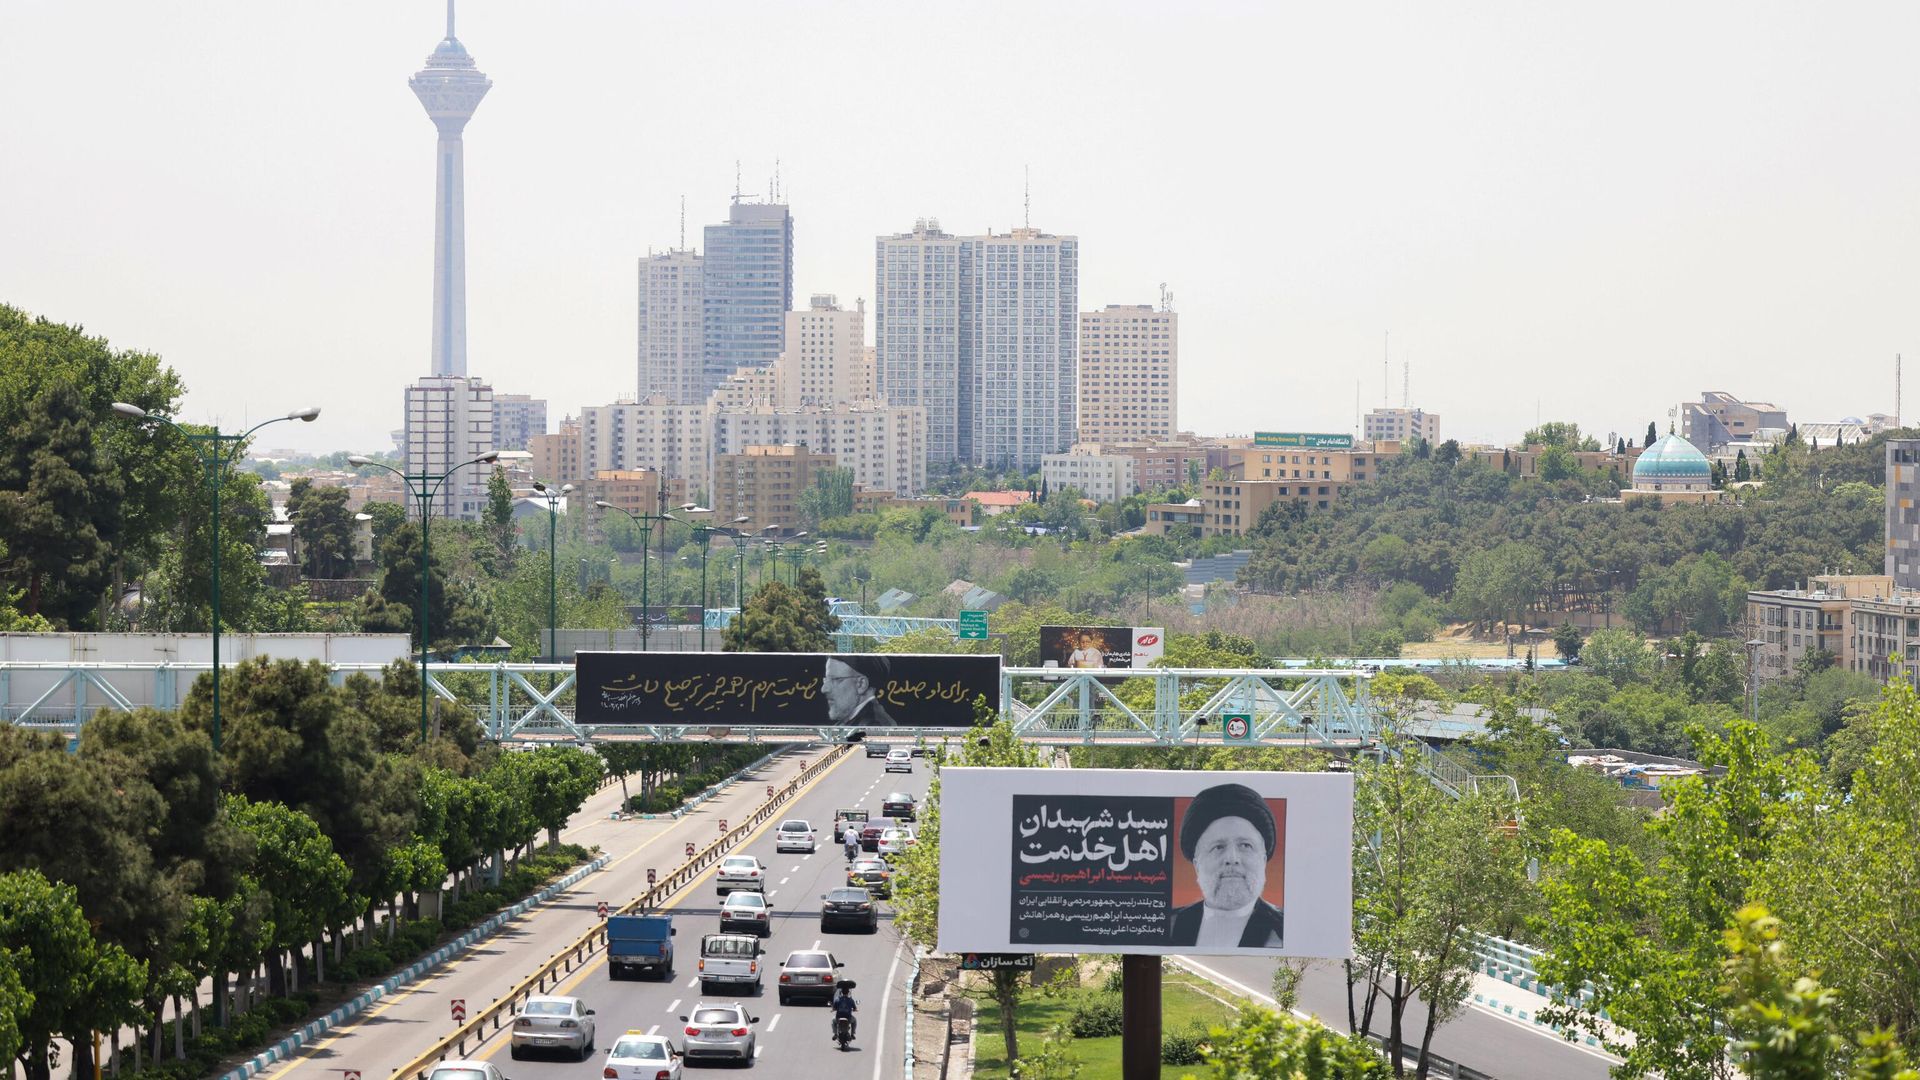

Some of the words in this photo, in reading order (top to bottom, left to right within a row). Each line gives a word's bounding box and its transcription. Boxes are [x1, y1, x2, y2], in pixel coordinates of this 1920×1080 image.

[601, 674, 659, 693] داشت
[722, 676, 743, 697] همه
[773, 669, 818, 708] رضایت
[664, 675, 703, 712] ترجیح
[696, 673, 726, 711] چیز
[737, 680, 753, 707] بر
[752, 680, 776, 712] مردم
[876, 688, 885, 699] و
[925, 681, 941, 700] او
[941, 680, 970, 703] برای
[1118, 809, 1168, 835] سید
[1020, 836, 1117, 864] خدمت
[1108, 833, 1167, 872] اهل
[1061, 867, 1105, 884] ابراهیم
[1106, 870, 1132, 883] سید
[1134, 869, 1167, 885] شهید
[1019, 896, 1038, 907] ایران
[1038, 896, 1062, 908] انقلابی
[1068, 898, 1090, 908] مردمی
[1138, 897, 1153, 907] بلند
[1153, 898, 1166, 908] روح
[1019, 910, 1060, 921] همراهانش
[1093, 910, 1123, 922] ابراهیم
[1123, 911, 1141, 921] سید
[1141, 912, 1166, 922] شهید
[1082, 924, 1111, 935] پیوست
[1111, 924, 1129, 936] اعلی
[1130, 923, 1157, 936] ملکوت
[1156, 926, 1165, 936] به
[980, 956, 1014, 969] سازان
[1014, 954, 1034, 966] آگه
